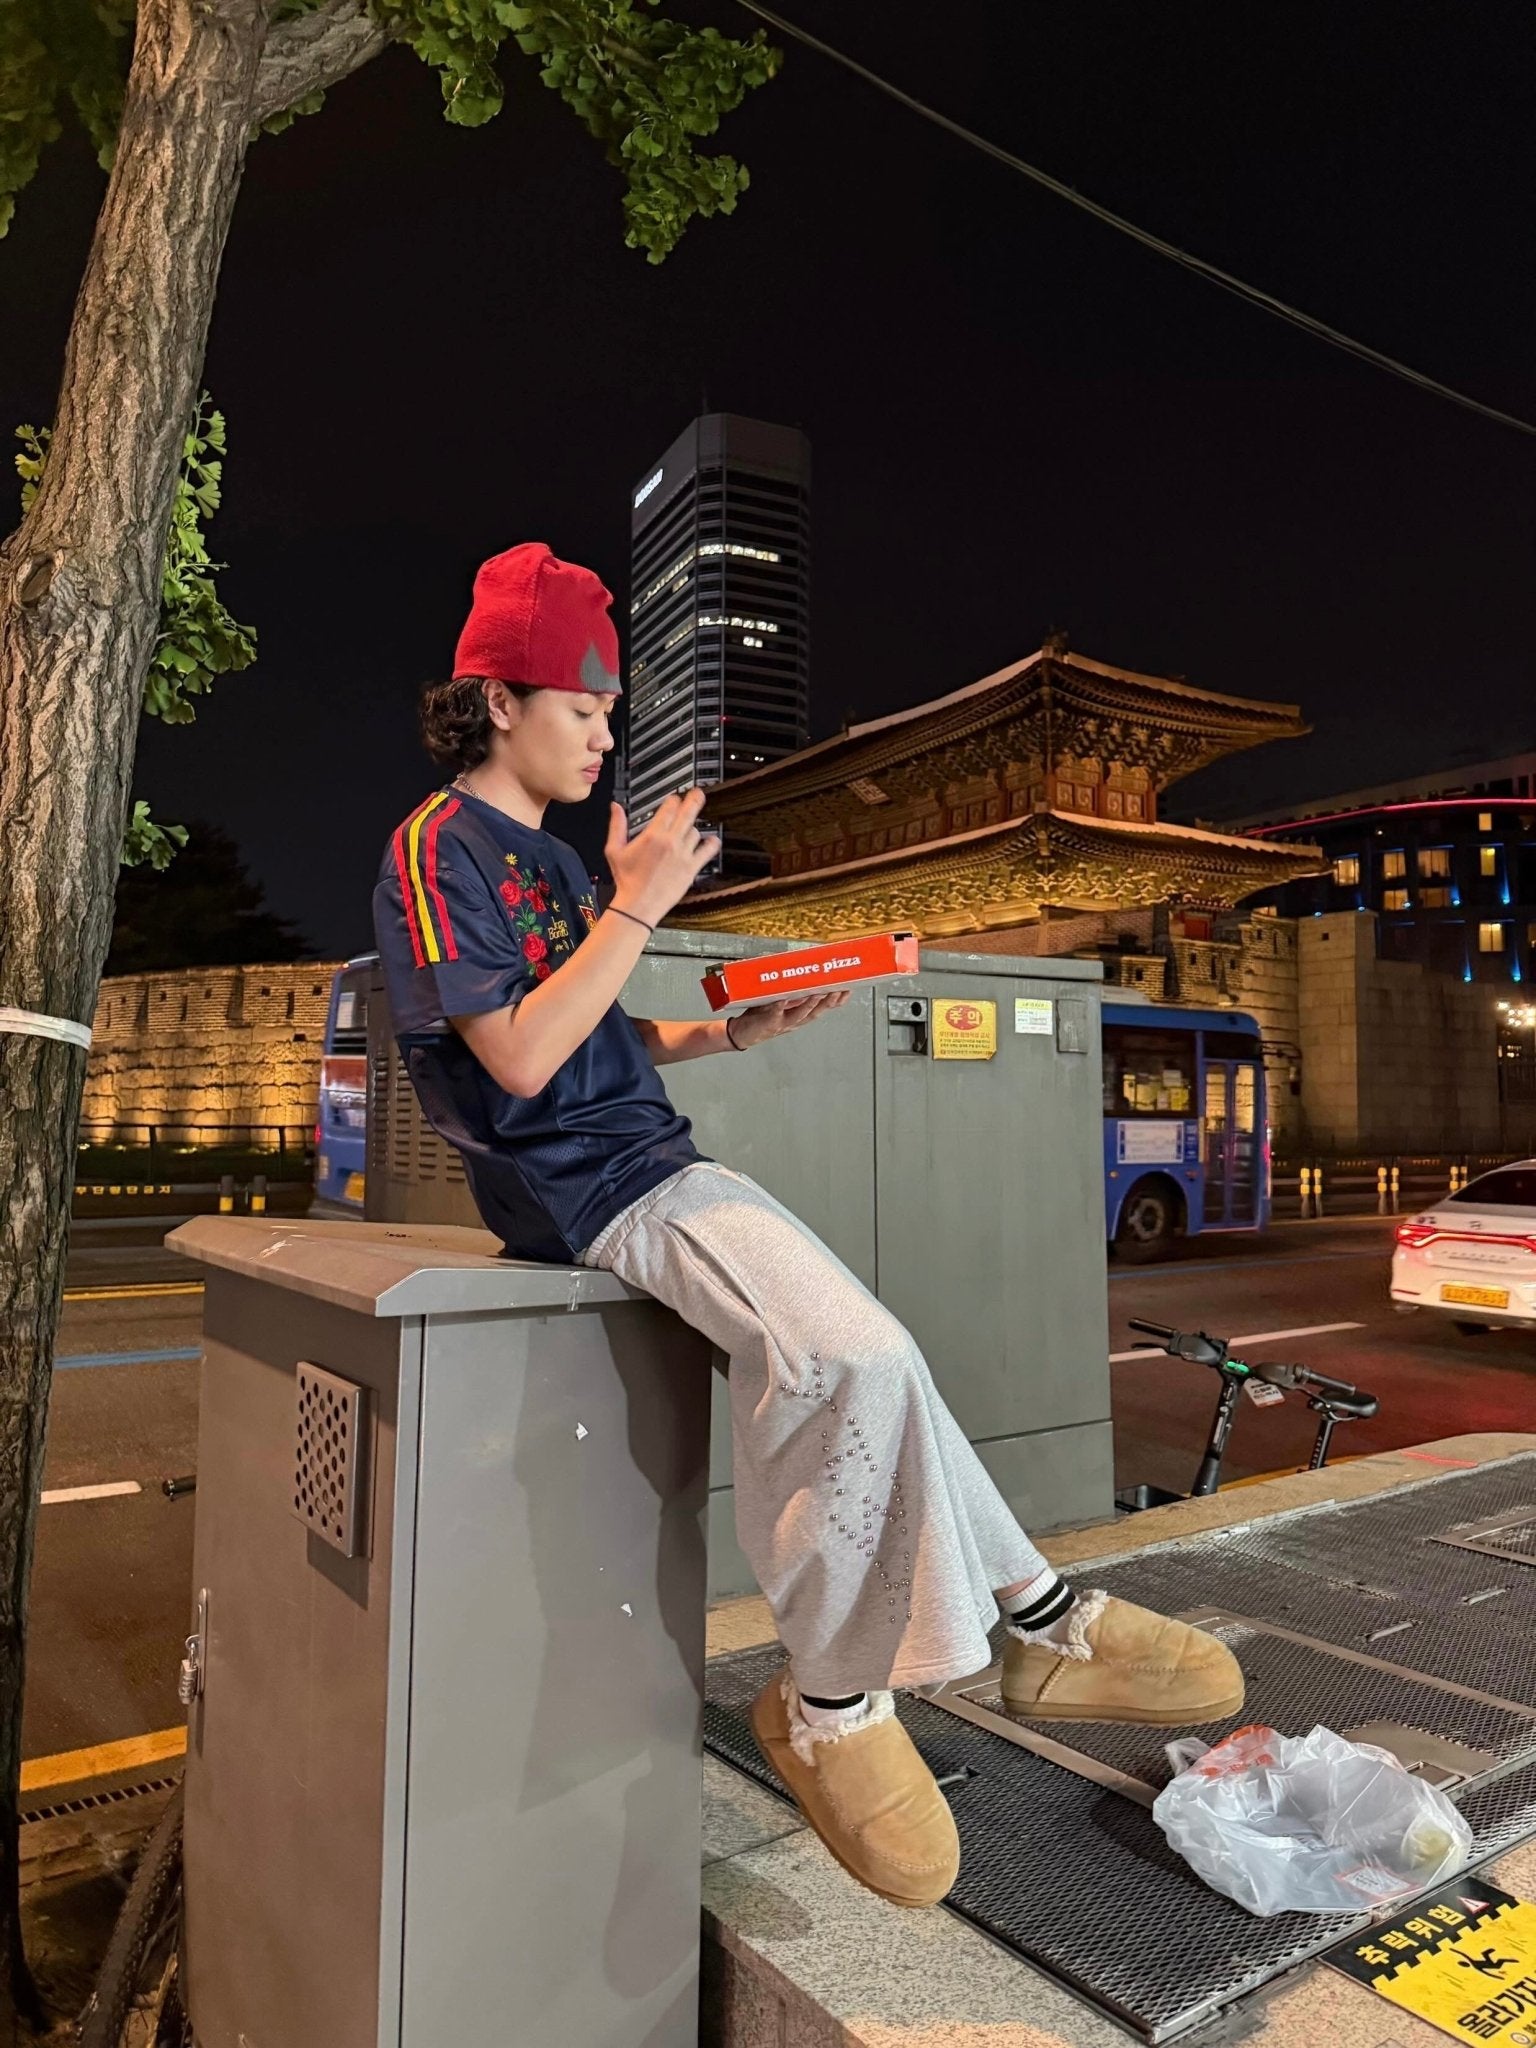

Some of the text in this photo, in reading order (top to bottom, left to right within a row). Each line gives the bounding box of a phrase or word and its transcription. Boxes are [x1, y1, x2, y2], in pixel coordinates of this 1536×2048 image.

[760, 955, 861, 982] no more pizza
